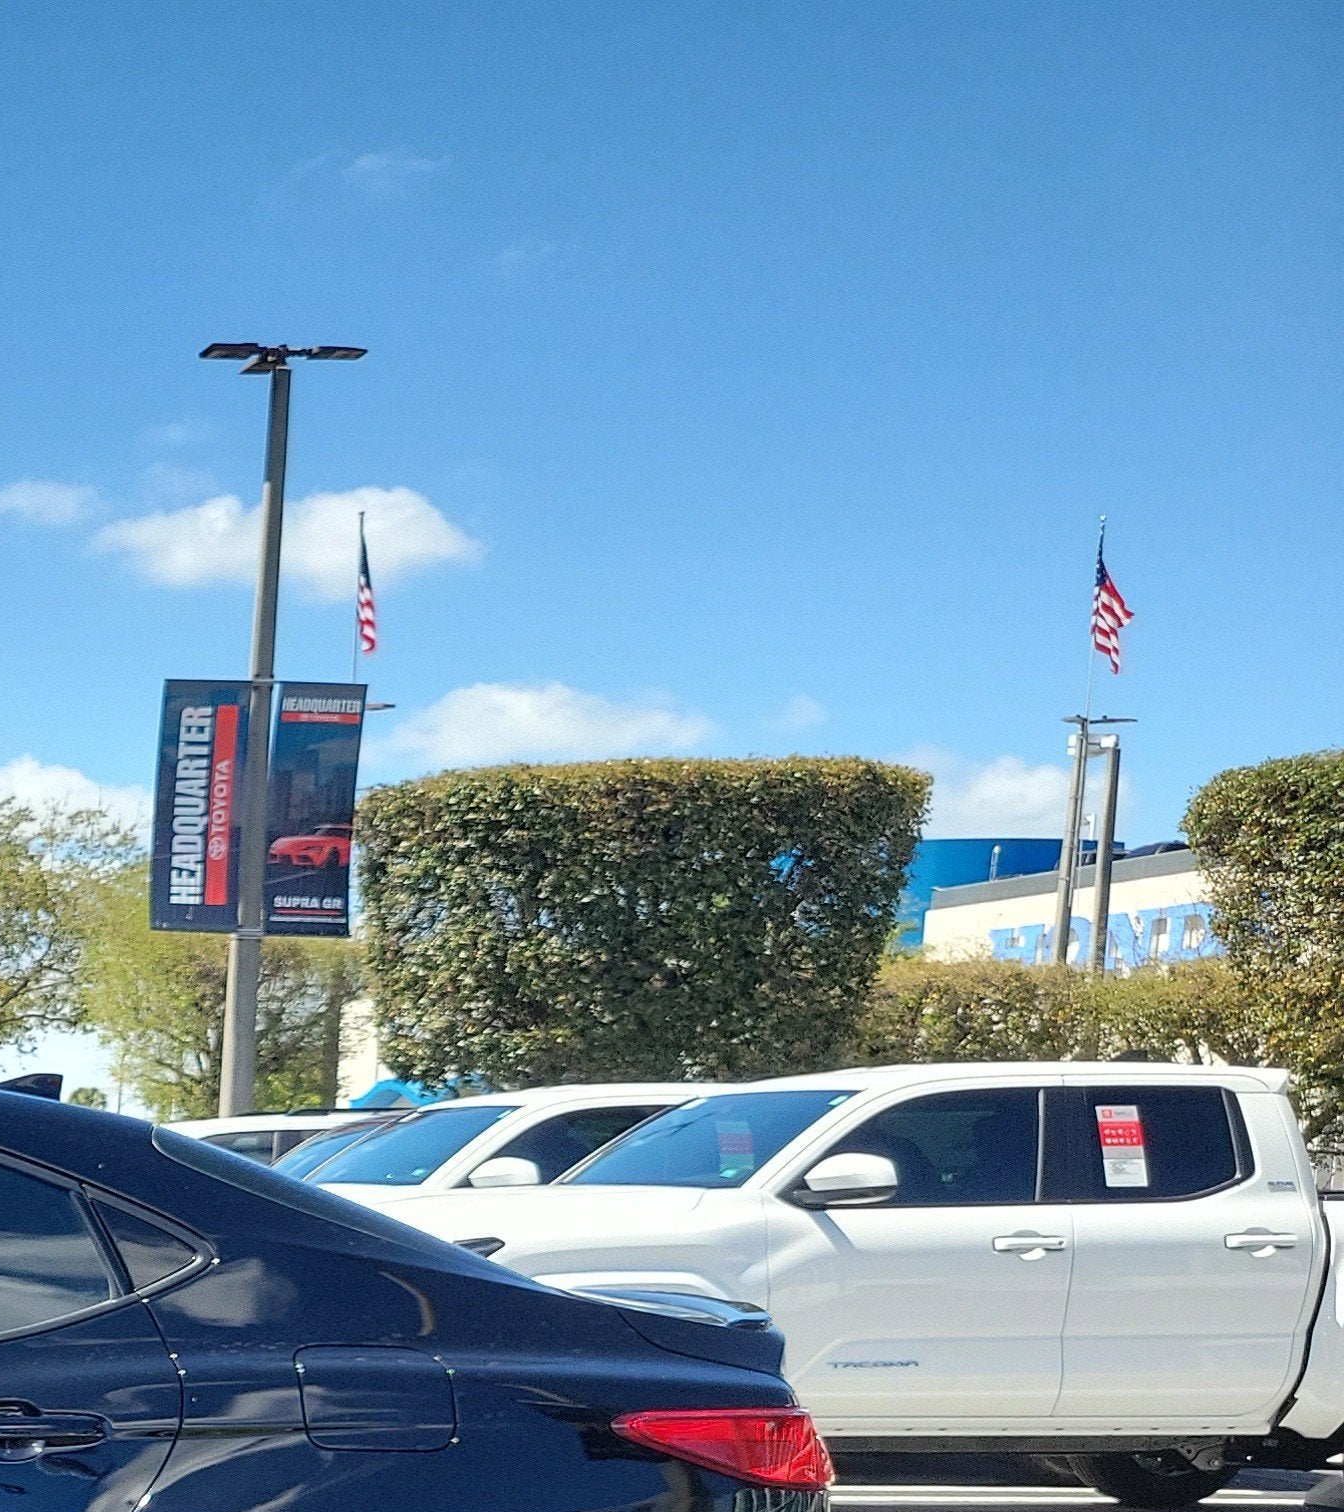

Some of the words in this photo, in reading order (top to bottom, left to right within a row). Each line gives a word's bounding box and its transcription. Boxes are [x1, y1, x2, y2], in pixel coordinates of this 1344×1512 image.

[281, 697, 363, 713] HEADQUARTER
[211, 759, 232, 833] TOYOTA
[169, 706, 214, 906] HEADQUARTER
[273, 896, 321, 909] SUPRA
[826, 1360, 919, 1369] TACOMA
